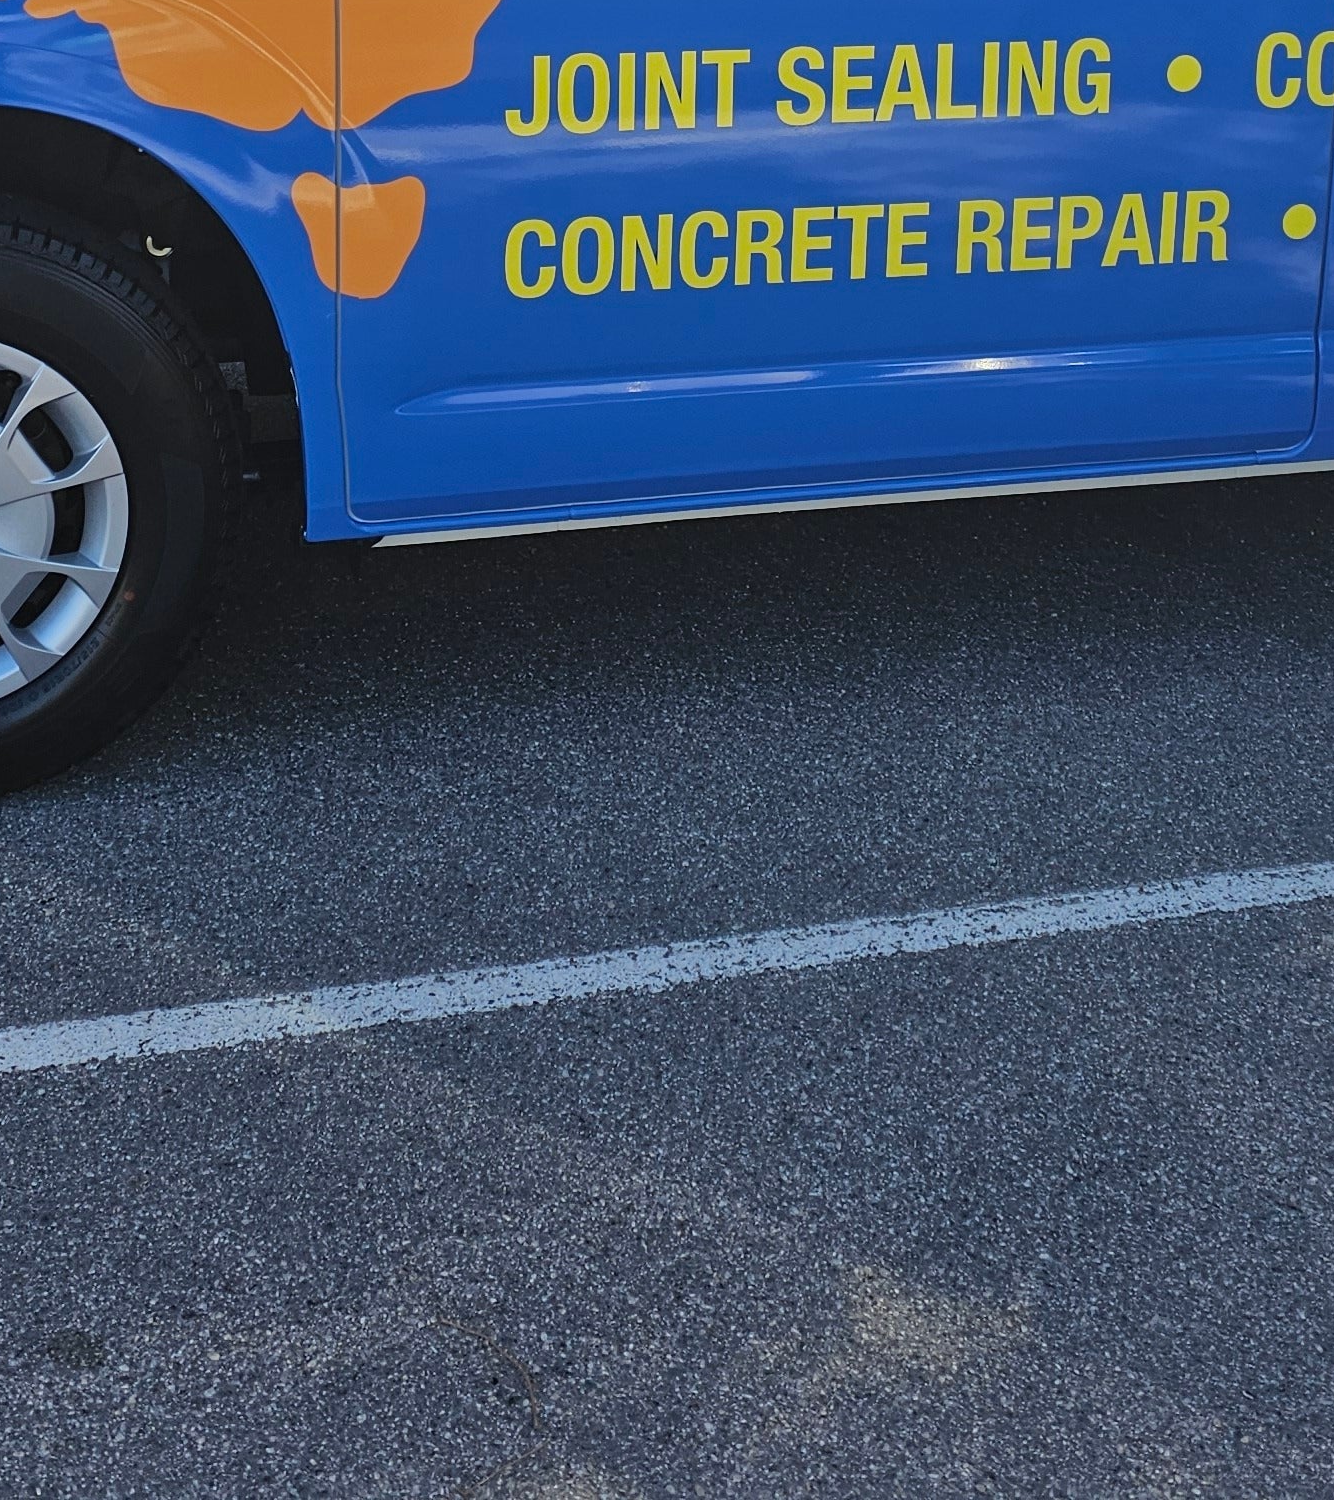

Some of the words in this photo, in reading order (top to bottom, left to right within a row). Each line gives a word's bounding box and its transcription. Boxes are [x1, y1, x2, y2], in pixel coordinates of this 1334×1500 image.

[505, 48, 751, 137] JOINT
[775, 36, 1112, 126] SEALING
[503, 201, 930, 299] CONCRETE
[955, 190, 1230, 275] REPAIR
